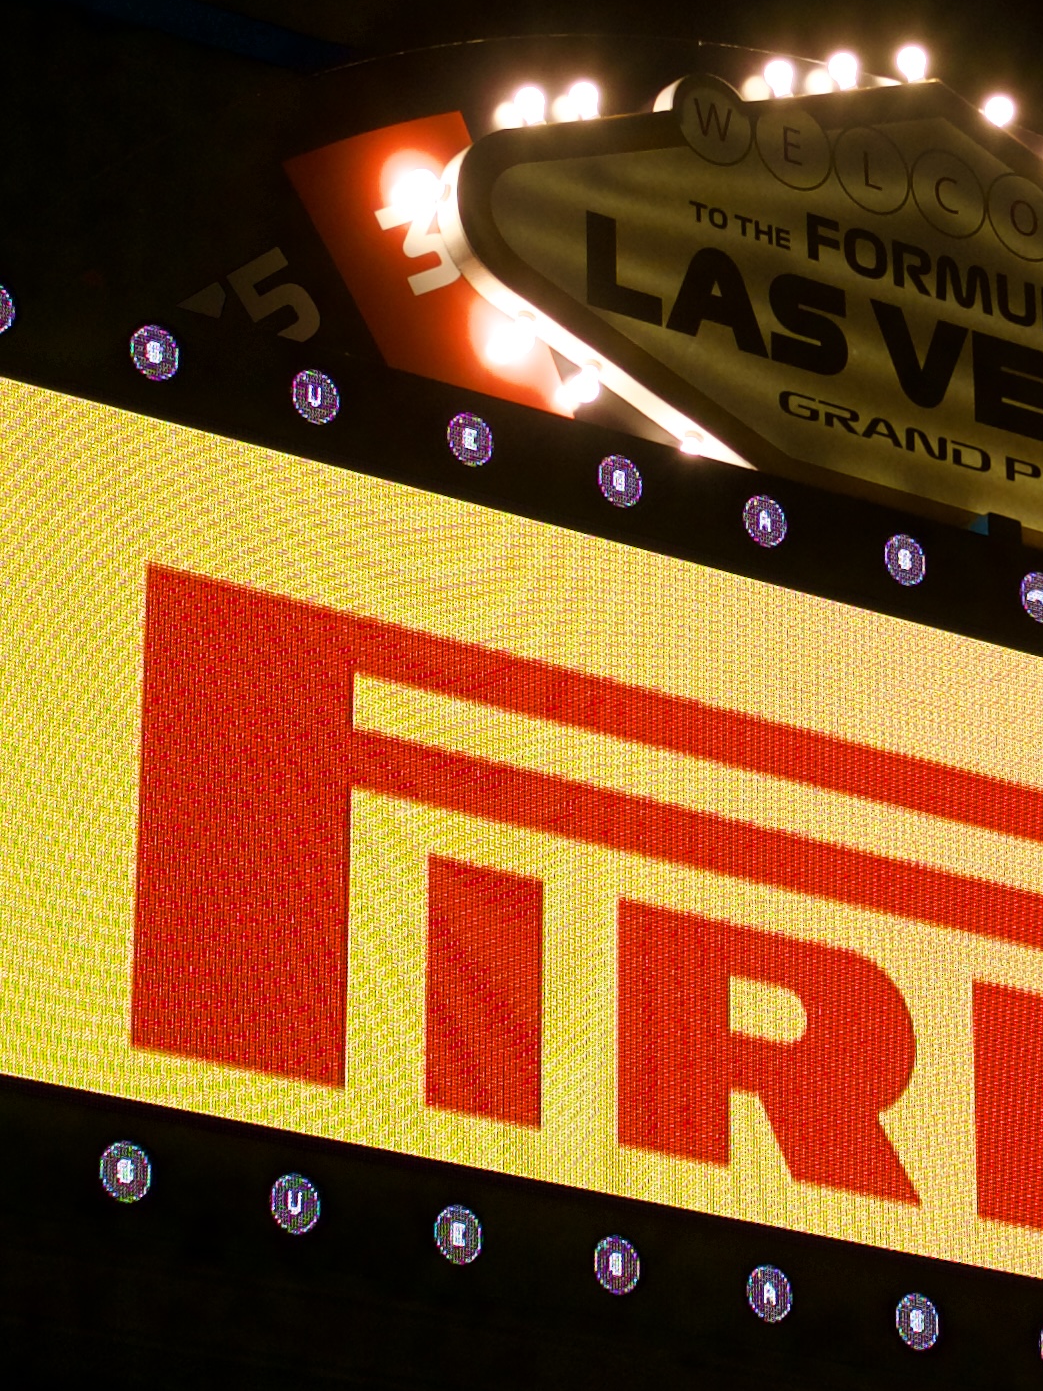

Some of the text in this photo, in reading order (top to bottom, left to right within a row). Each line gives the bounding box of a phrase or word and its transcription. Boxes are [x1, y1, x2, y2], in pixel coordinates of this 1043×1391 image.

[689, 200, 728, 230] TO
[734, 213, 791, 250] THE
[586, 210, 849, 377] LAS
[779, 390, 992, 472] GRAND
